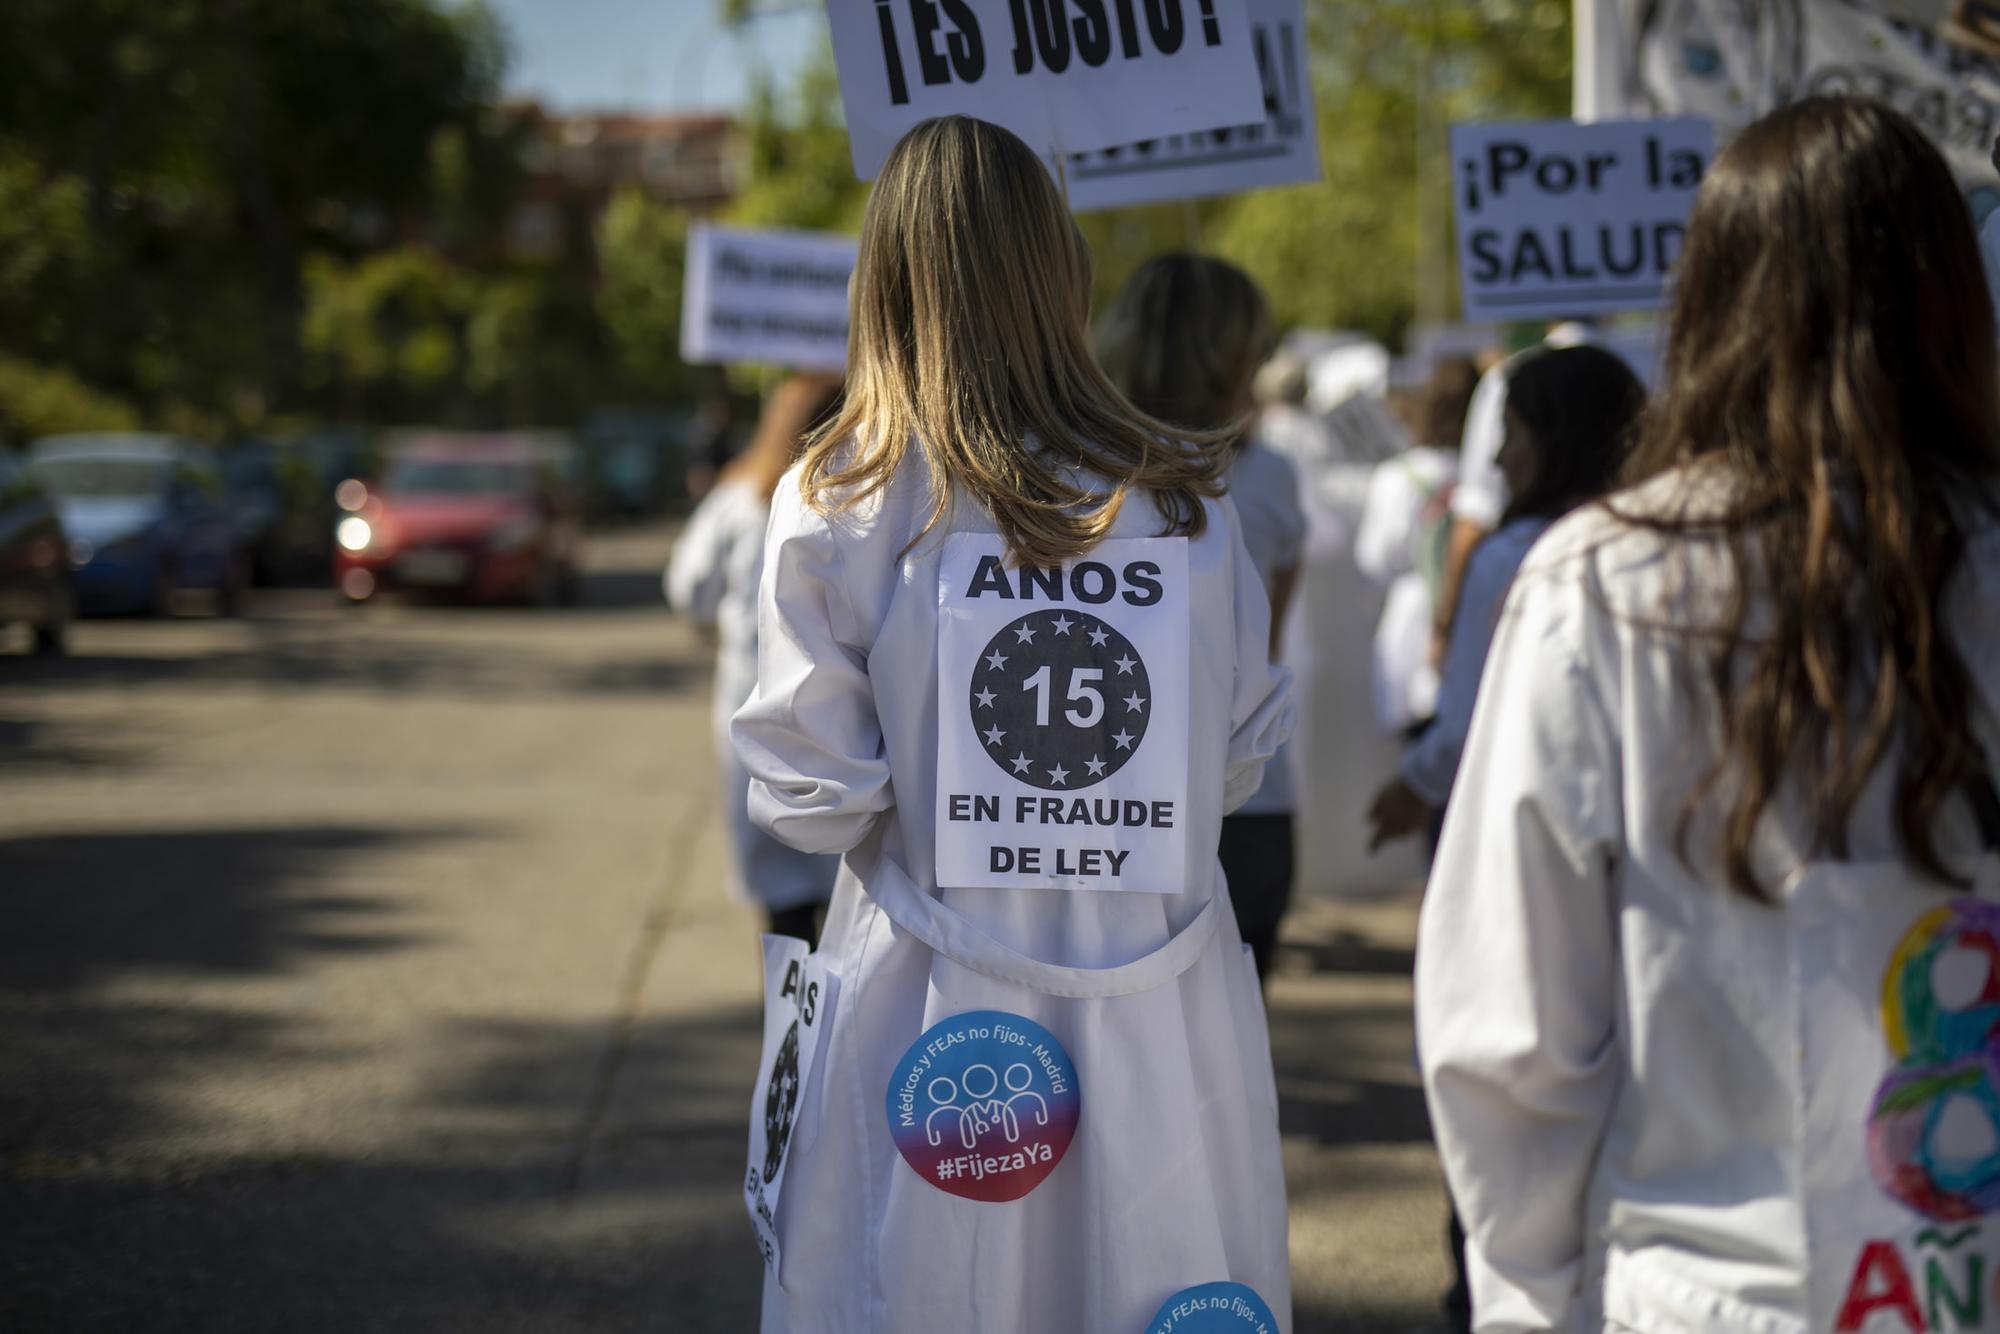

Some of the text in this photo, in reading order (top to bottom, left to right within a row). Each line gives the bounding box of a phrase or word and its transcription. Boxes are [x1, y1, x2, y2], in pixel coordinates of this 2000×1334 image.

[1463, 136, 1702, 211] ¡Por la
[1022, 666, 1105, 728] 15
[949, 795, 1174, 828] EN FRAUDE
[990, 846, 1129, 876] DE LEY
[926, 1029, 966, 1057] FEAs
[969, 1027, 989, 1040] no
[993, 1024, 1026, 1047] fijos
[921, 1055, 932, 1069] y
[1032, 1044, 1068, 1095] Madrid
[898, 1063, 923, 1127] Médicos
[936, 1142, 1053, 1180] #FijezaYa
[1833, 1224, 2000, 1334] AÑ
[1163, 1318, 1172, 1332] y
[1171, 1298, 1207, 1322] FEAs
[1210, 1297, 1229, 1309] no
[1231, 1296, 1256, 1322] fijos
